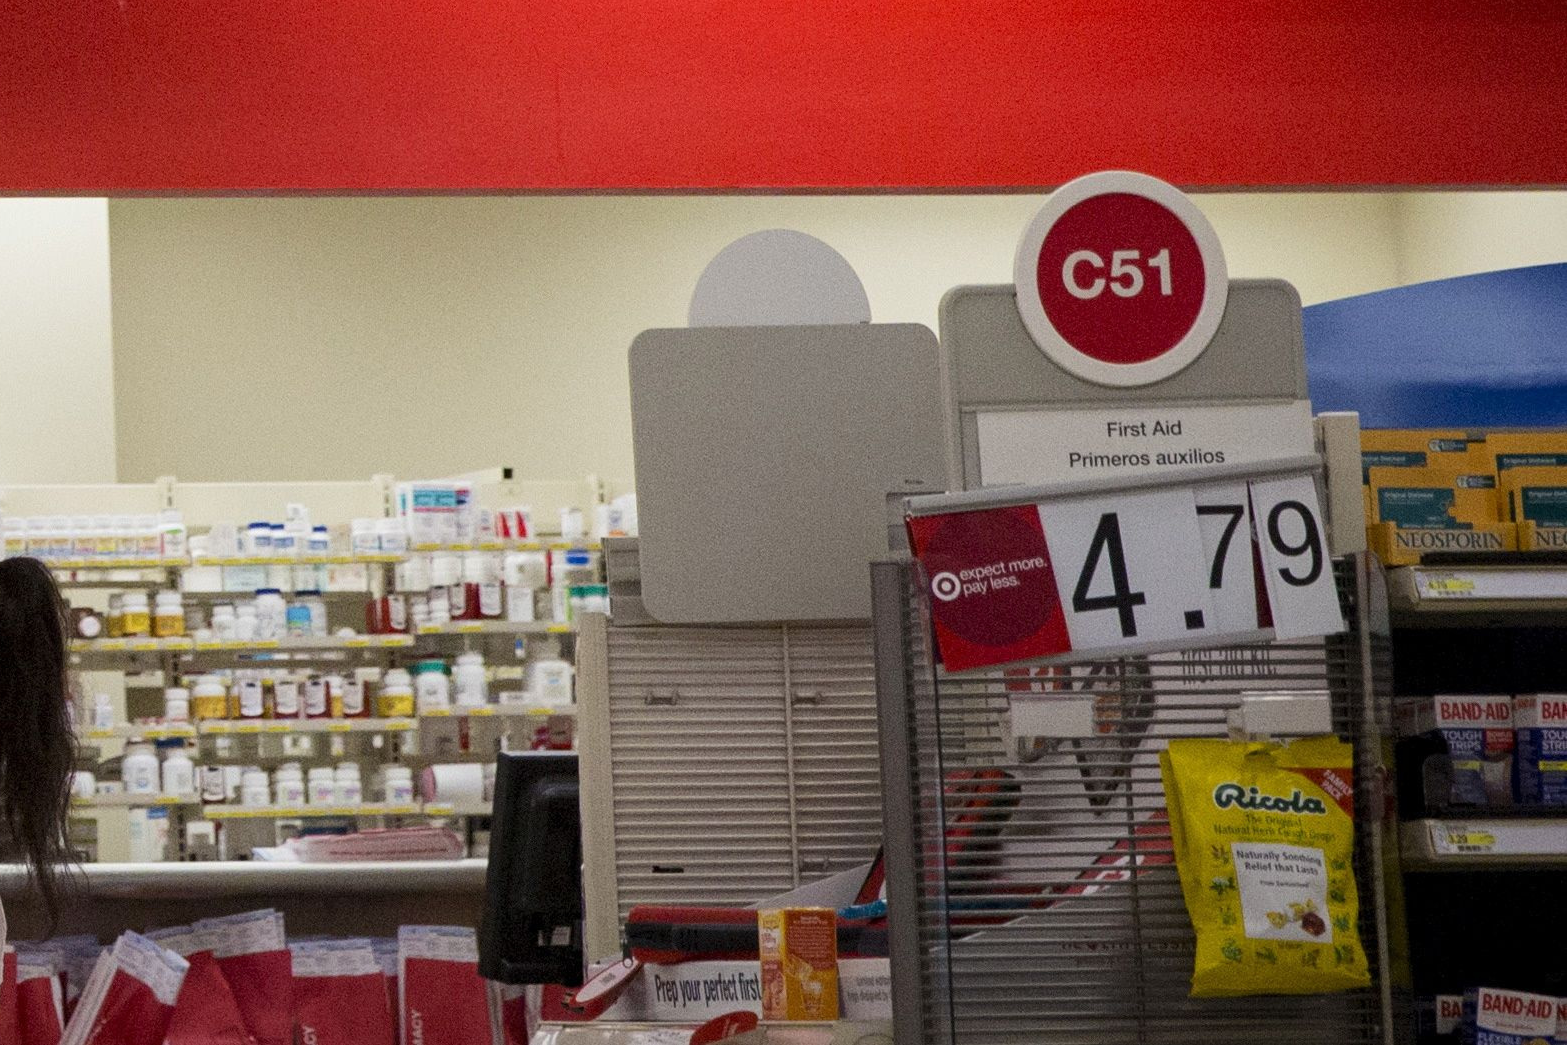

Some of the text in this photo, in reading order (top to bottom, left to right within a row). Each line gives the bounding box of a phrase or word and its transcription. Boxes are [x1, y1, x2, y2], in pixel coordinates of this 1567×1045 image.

[1061, 249, 1174, 300] C51
[1106, 419, 1183, 438] First Aid
[1068, 448, 1226, 469] Primeros auxilios
[1396, 532, 1503, 549] NEOSPORIN
[960, 556, 1048, 582] expect more.
[1071, 498, 1324, 639] 4.79
[962, 576, 1021, 597] pay less.
[1440, 702, 1510, 721] BAND-AID
[1214, 784, 1326, 814] Ricola
[1236, 850, 1281, 861] Naturally
[1245, 862, 1273, 872] Relief
[1275, 863, 1294, 872] that
[655, 974, 763, 1006] Prep your perfect first
[1482, 993, 1553, 1019] BAND-AID
